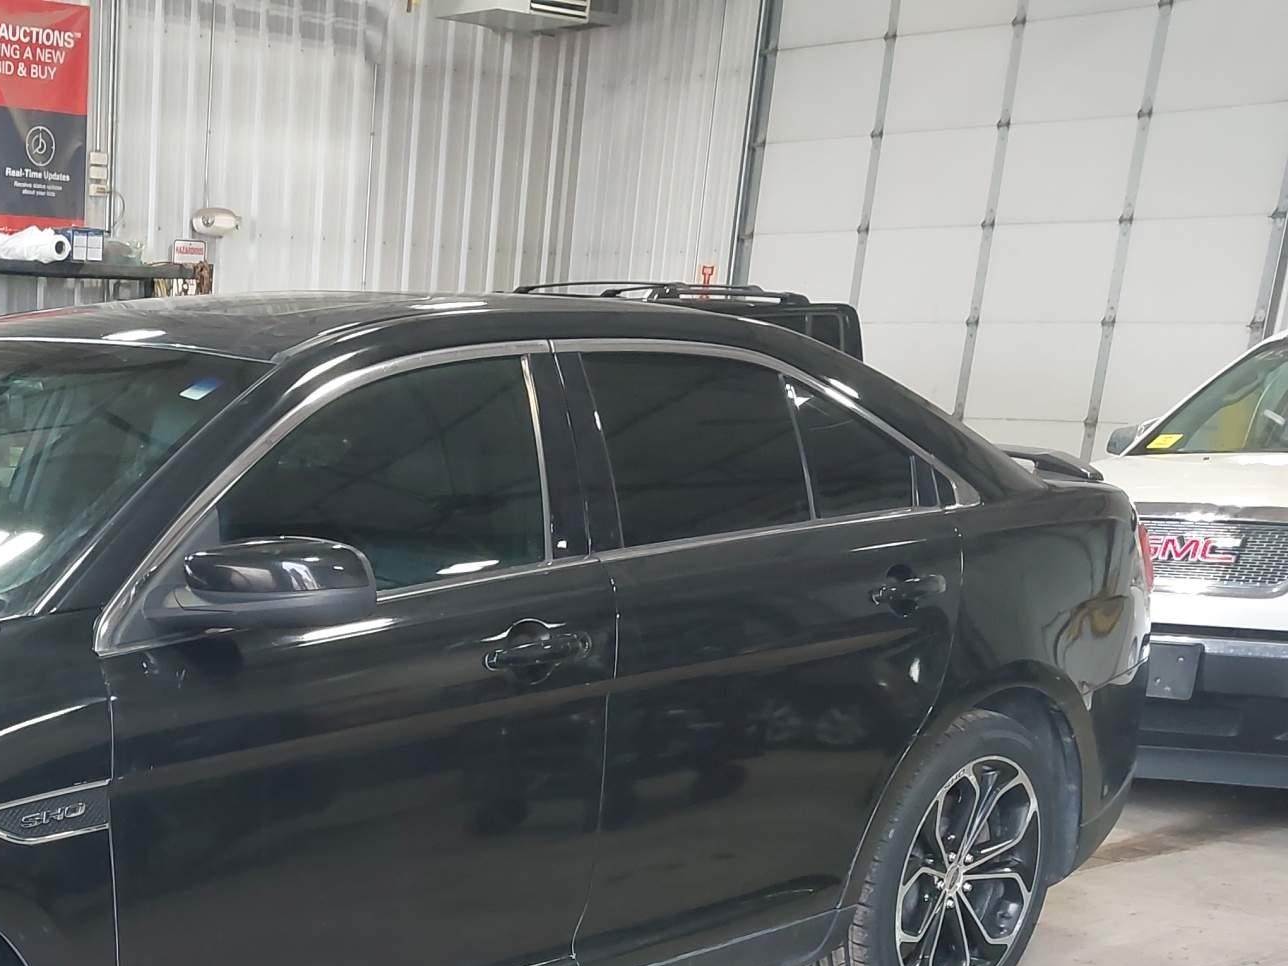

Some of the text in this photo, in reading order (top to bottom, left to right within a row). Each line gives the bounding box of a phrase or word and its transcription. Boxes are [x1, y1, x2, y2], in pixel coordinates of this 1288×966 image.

[23, 49, 33, 60] A
[36, 48, 65, 64] NEW
[17, 66, 27, 78] &
[30, 66, 57, 80] BUY
[5, 166, 71, 182] Real-Time Updates
[21, 801, 86, 828] SHO
